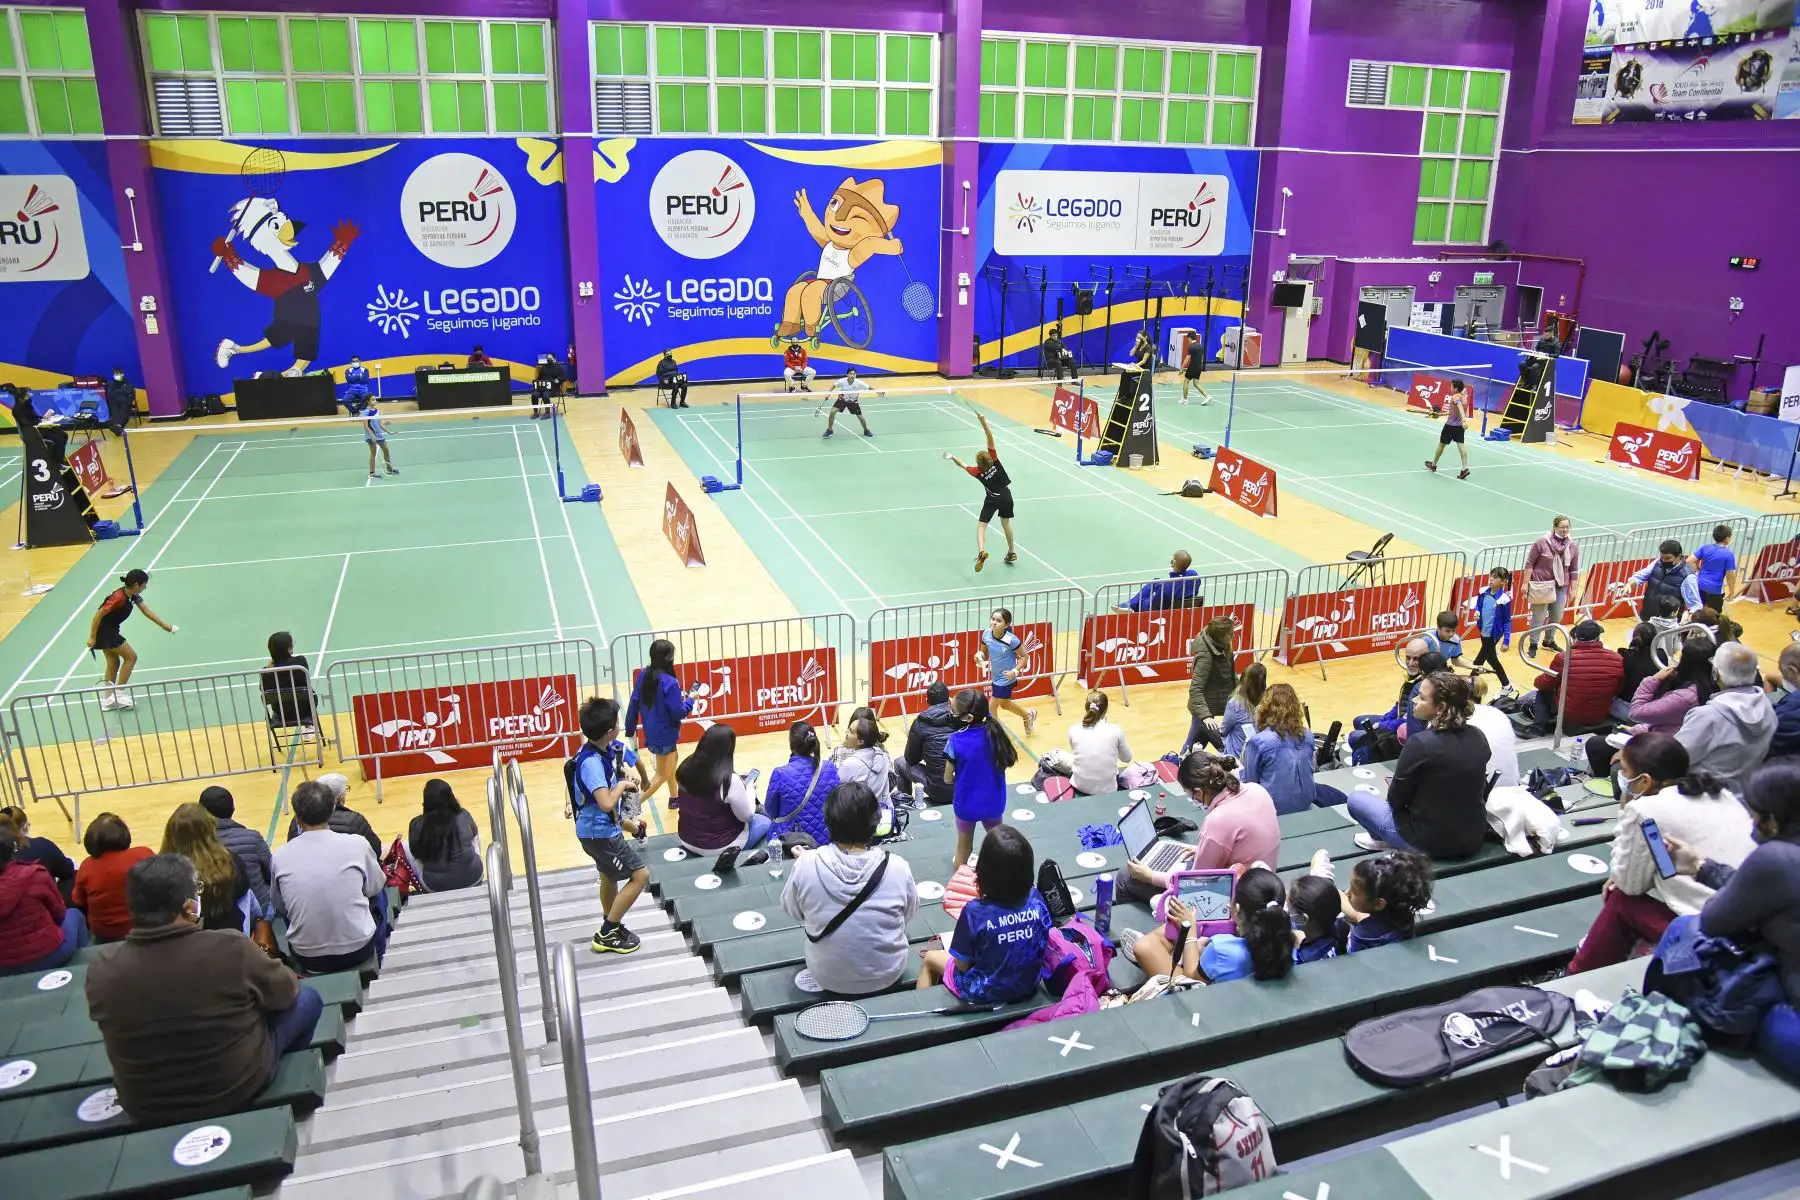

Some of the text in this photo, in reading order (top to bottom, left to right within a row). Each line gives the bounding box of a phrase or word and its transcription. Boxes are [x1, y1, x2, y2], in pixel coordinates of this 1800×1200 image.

[1046, 219, 1121, 231] Seguimos jugando
[667, 303, 772, 320] Seguimos jugando
[427, 313, 541, 333] Seguimos jugando
[1543, 381, 1552, 397] 1
[1138, 393, 1150, 412] 2
[32, 458, 50, 482] 3
[1116, 645, 1146, 663] IPD
[400, 728, 436, 748] IPD
[986, 907, 1040, 930] A. MONZÓN
[998, 924, 1033, 944] PERÚ
